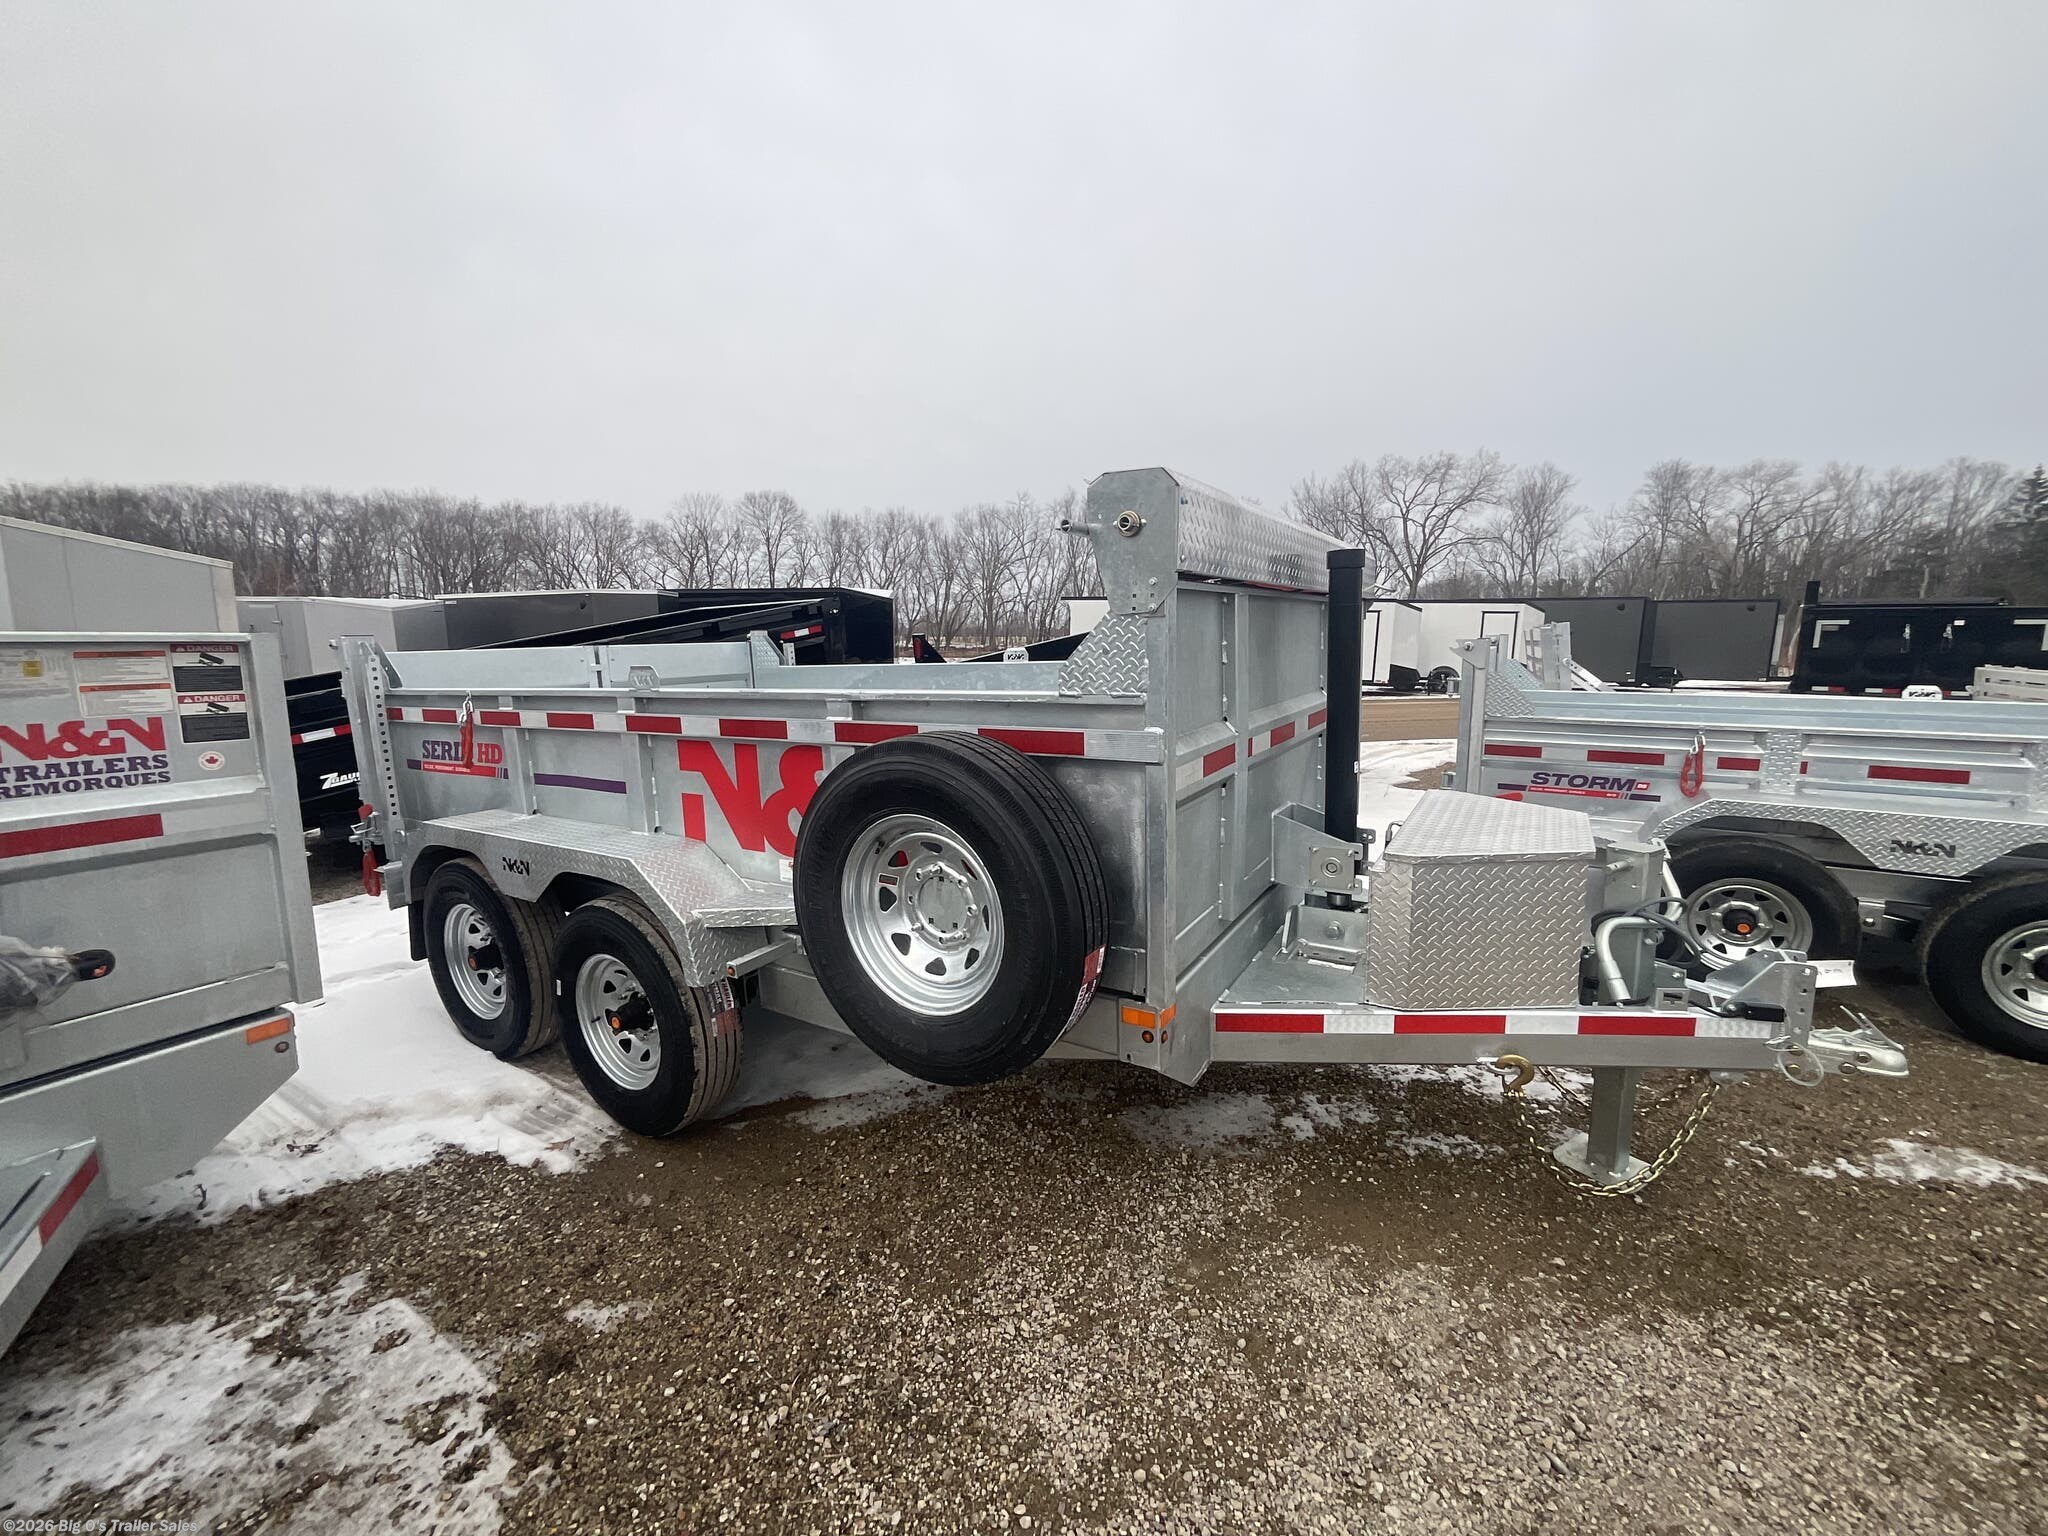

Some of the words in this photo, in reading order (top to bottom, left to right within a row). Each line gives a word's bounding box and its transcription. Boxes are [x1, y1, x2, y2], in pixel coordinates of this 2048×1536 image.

[194, 694, 241, 703] DANGER
[0, 716, 166, 763] N&N
[477, 743, 503, 765] HD
[0, 754, 168, 784] TRAILERS
[1530, 772, 1636, 792] STORM
[0, 771, 171, 800] REMORQUES
[677, 739, 823, 858] N&
